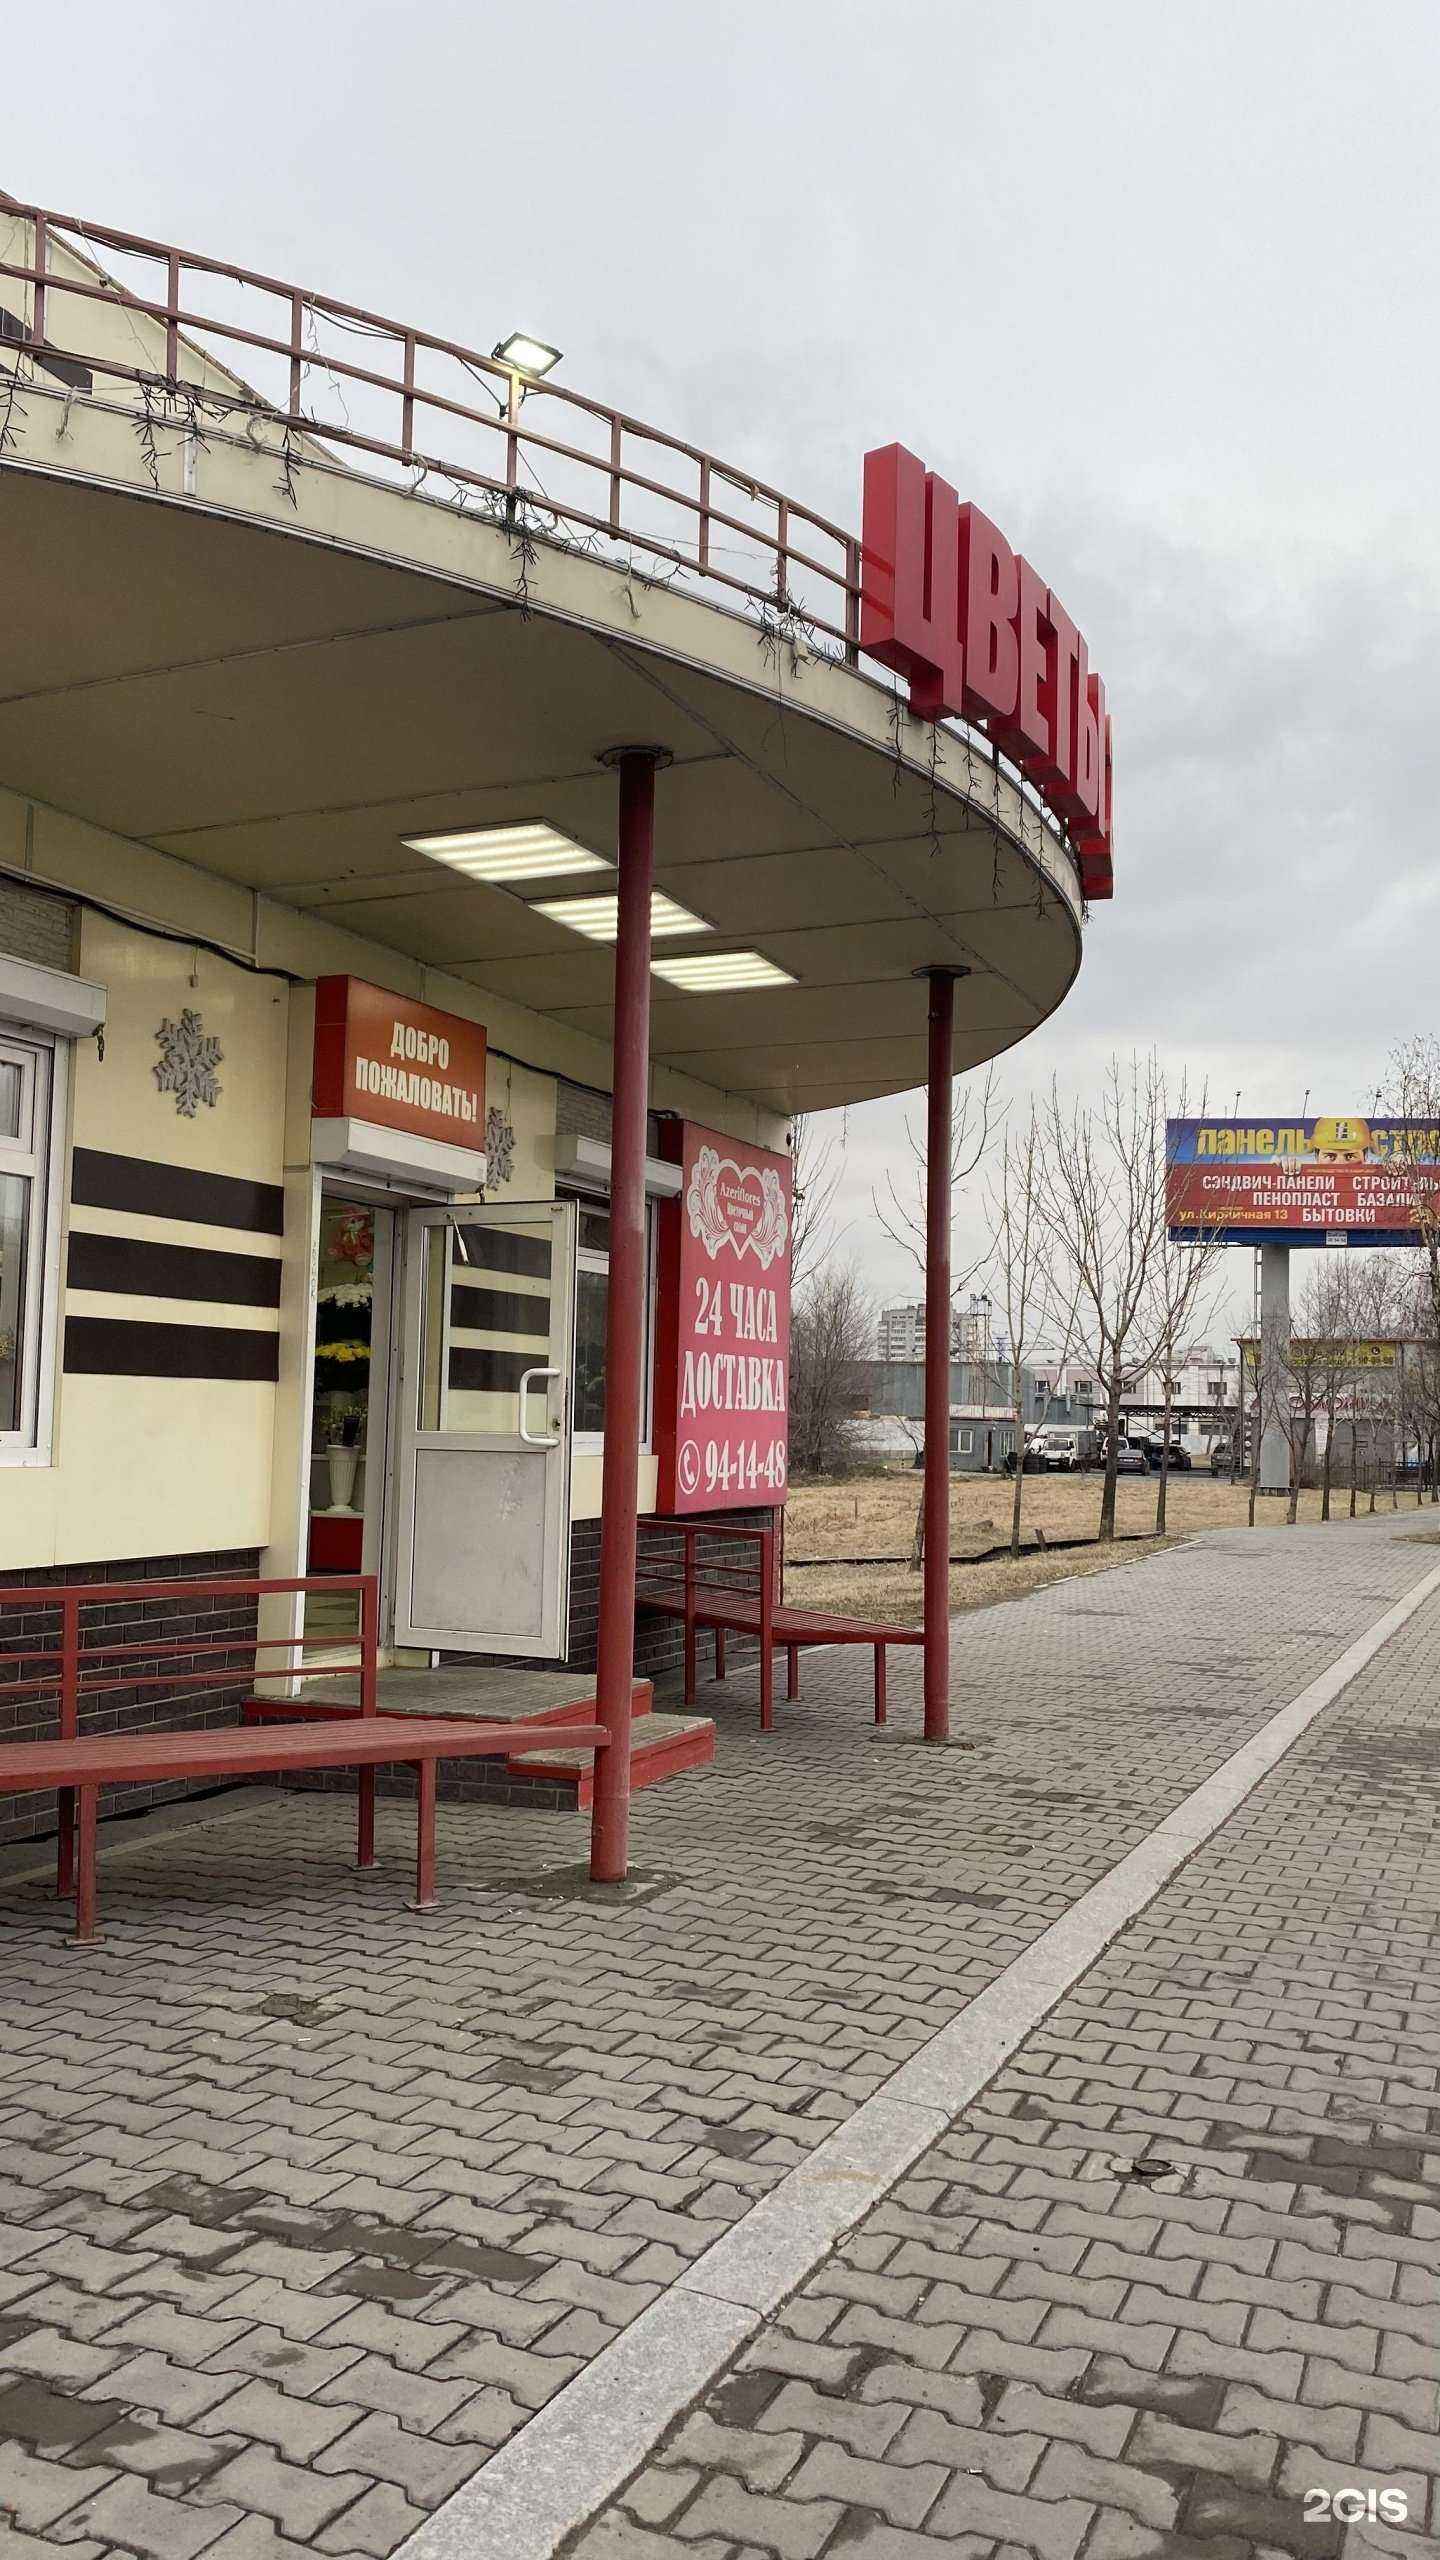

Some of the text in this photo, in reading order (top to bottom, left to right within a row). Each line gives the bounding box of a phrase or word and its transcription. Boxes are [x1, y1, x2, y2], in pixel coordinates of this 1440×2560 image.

[862, 442, 1110, 850] ЦВЕТЫ
[390, 1021, 449, 1070] ДОБРО
[355, 1056, 477, 1123] ПОЖАЛОВАТЬ!
[1203, 1175, 1335, 1192] СЭНДВИЧ-ПАНЕЛИ
[1253, 1192, 1340, 1206] ПЕНОПЛАСТ
[1302, 1208, 1375, 1223] БЫТОВКИ
[694, 1277, 778, 1344] 24 ЧАСА
[680, 1350, 786, 1418] ДОСТАВКА
[705, 1438, 786, 1493] 94-14-48
